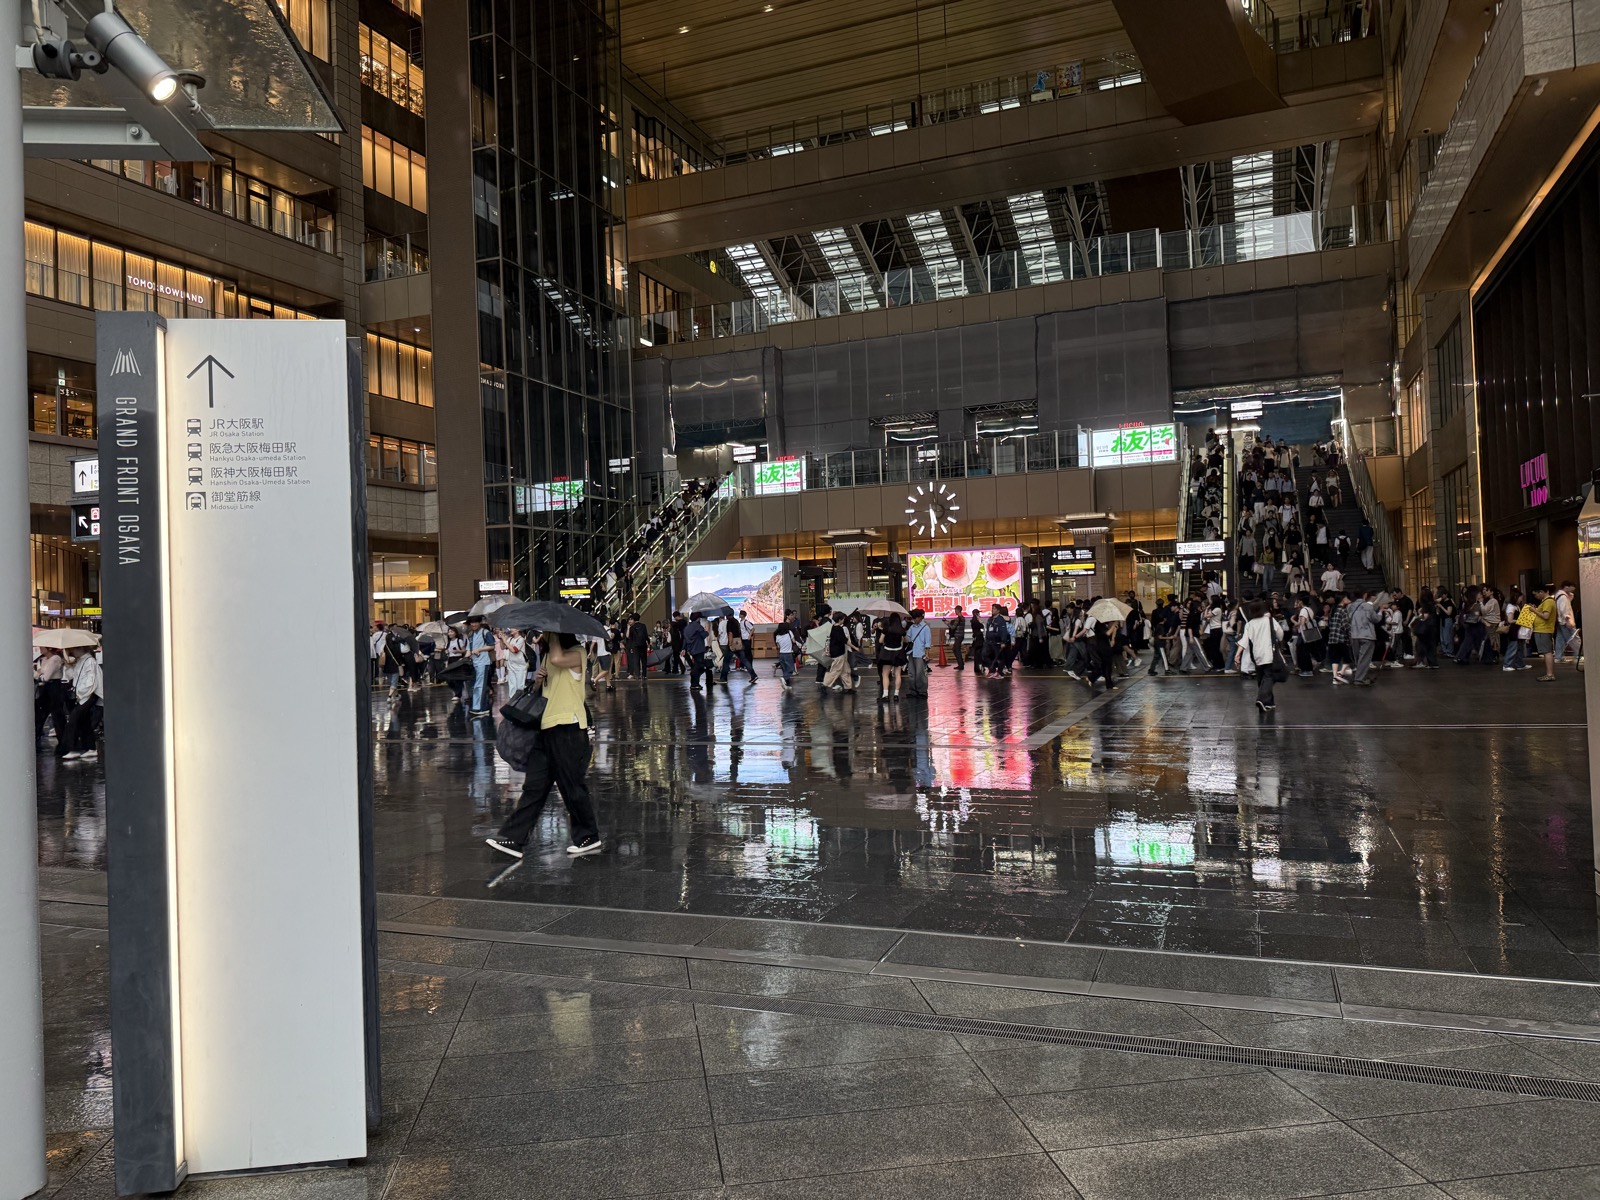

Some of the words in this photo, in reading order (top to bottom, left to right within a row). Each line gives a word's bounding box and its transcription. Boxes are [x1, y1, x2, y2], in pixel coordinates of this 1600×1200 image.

[115, 397, 138, 447] GRAND
[209, 417, 265, 430] JR大阪駅
[209, 442, 297, 454] 阪急大阪梅田駅
[209, 455, 234, 463] Hankyu
[210, 466, 298, 478] 阪神大阪梅田駅
[116, 457, 139, 505] FRONT
[211, 490, 262, 502] 御堂筋線
[118, 514, 141, 565] OSAKA
